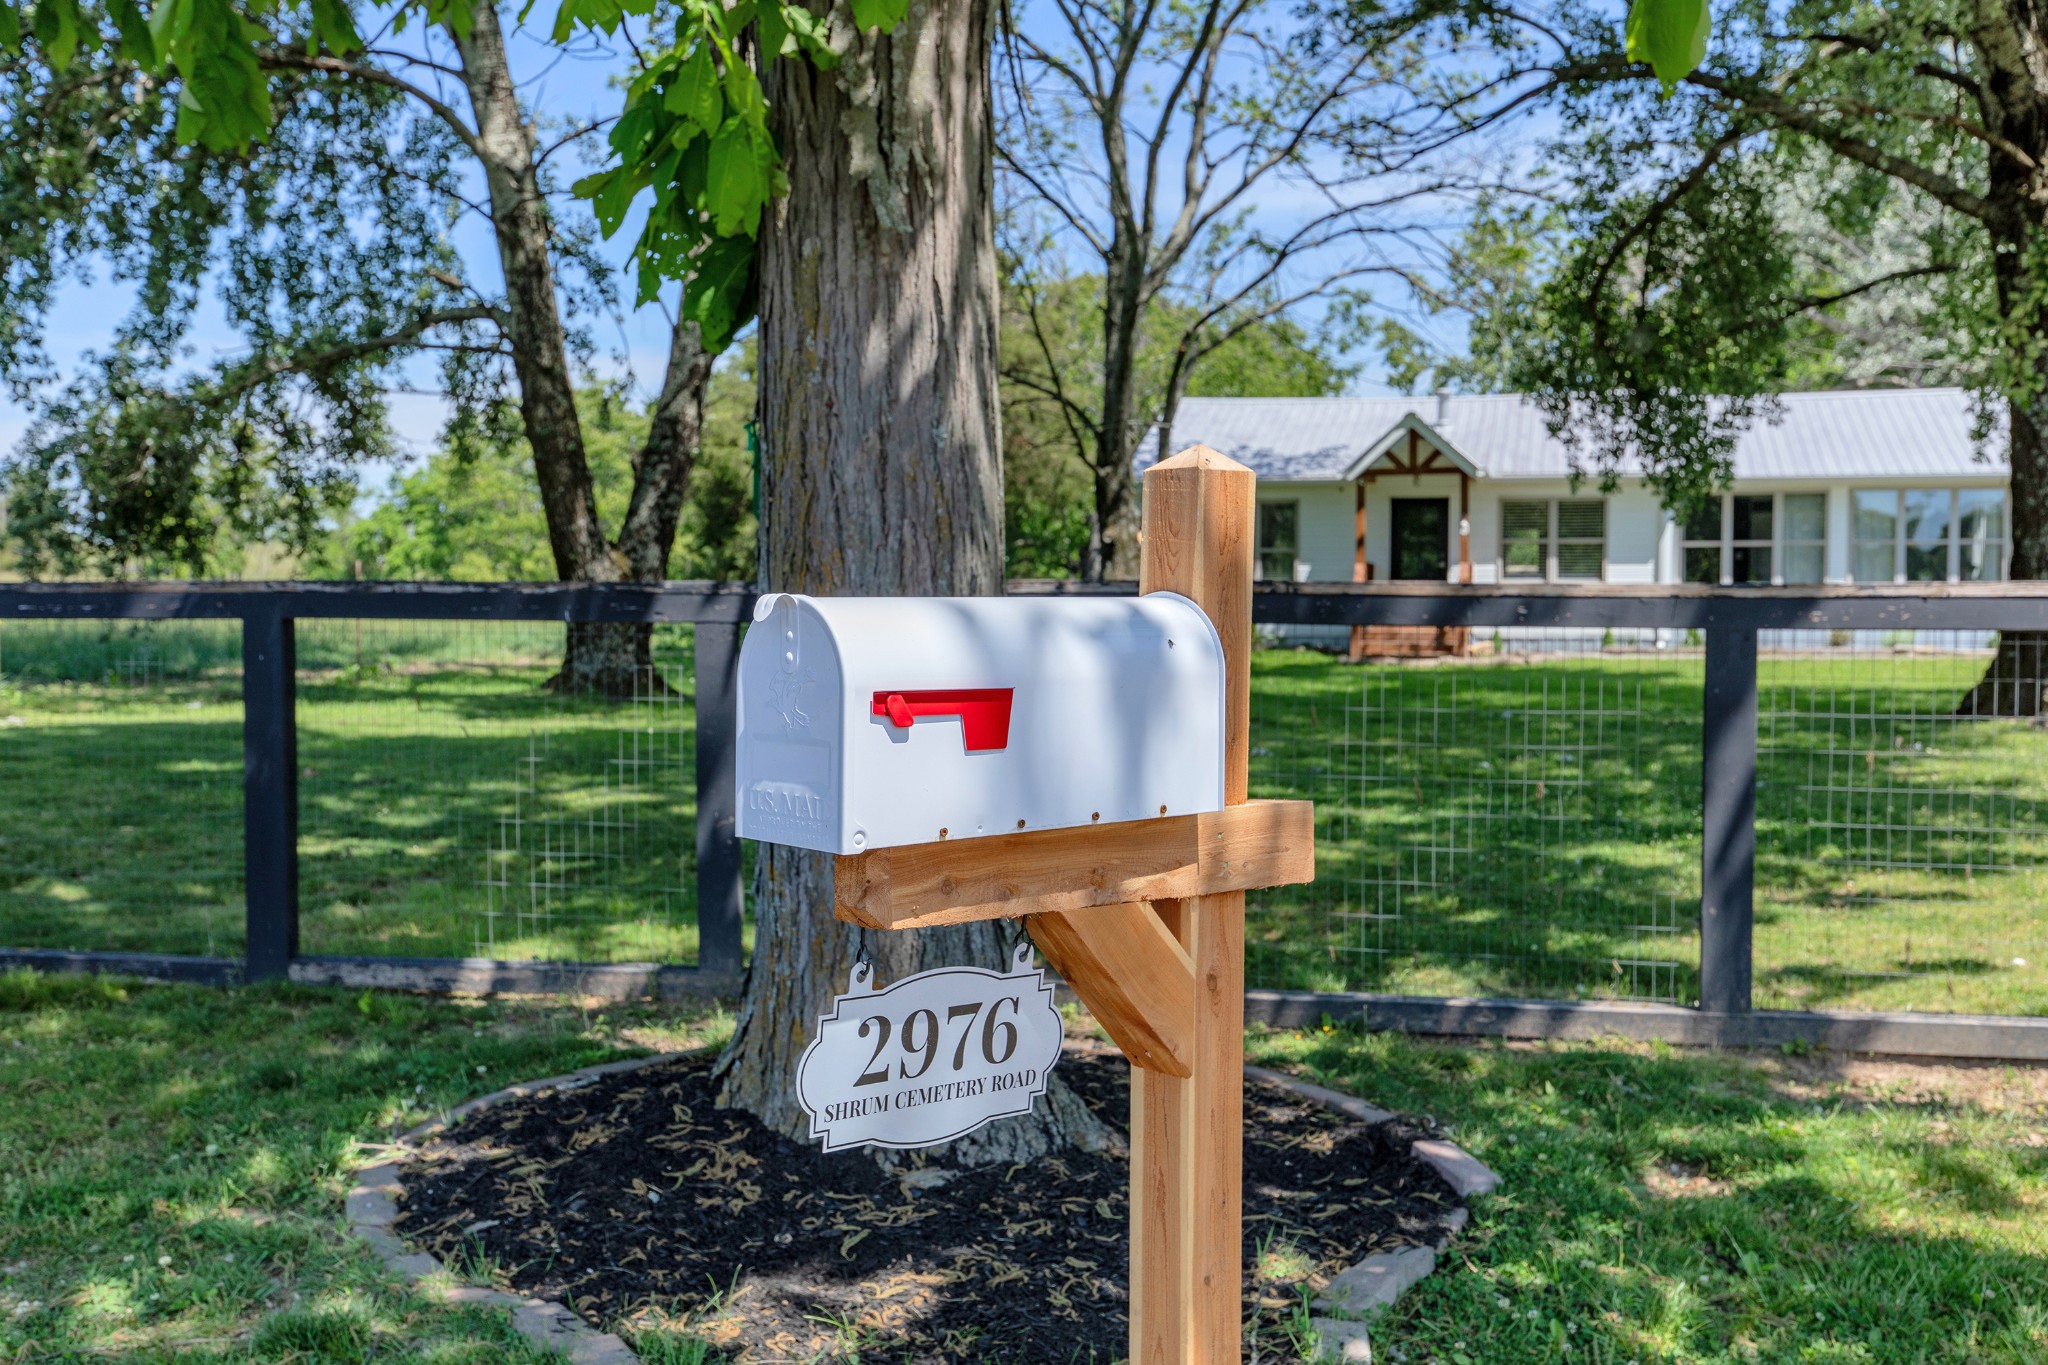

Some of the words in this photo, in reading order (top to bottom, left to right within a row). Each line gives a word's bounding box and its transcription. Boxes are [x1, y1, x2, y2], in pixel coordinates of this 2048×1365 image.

[853, 996, 1020, 1088] 2976
[824, 1094, 890, 1123] SHRUM
[895, 1077, 987, 1110] CEMETERY
[990, 1069, 1036, 1092] ROAD
